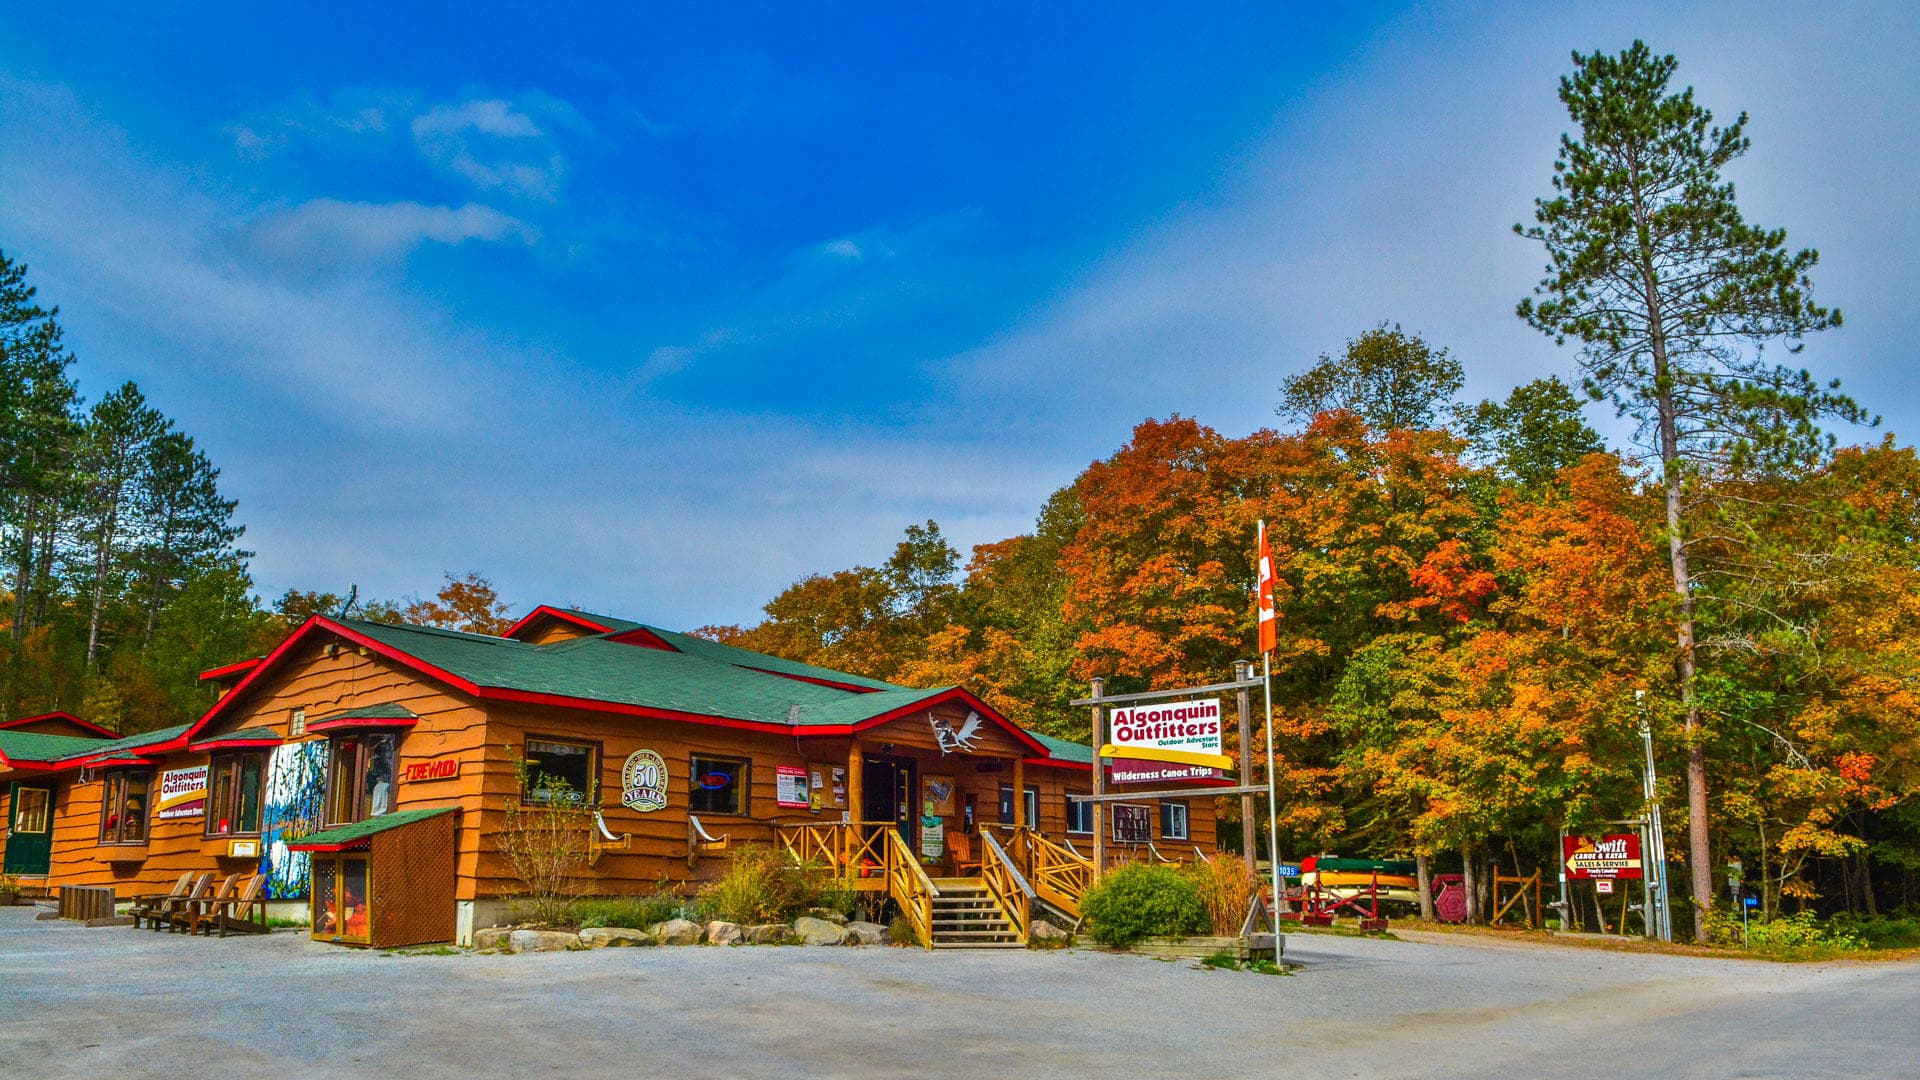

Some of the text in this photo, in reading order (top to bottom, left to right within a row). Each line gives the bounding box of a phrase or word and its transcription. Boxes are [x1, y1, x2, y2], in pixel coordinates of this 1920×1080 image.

[1113, 702, 1218, 728] Algonquin
[1117, 722, 1218, 742] Outfitters
[1158, 736, 1218, 746] Outdoor Adventure
[164, 768, 207, 784] Algonquin
[405, 760, 457, 781] FIREWOOD
[633, 764, 657, 788] 50
[1112, 766, 1213, 781] Wilderness Canoe Trips
[162, 781, 204, 793] Outfitters
[628, 789, 663, 803] YEARS
[1594, 839, 1627, 853] Swift
[1279, 866, 1295, 876] 1035
